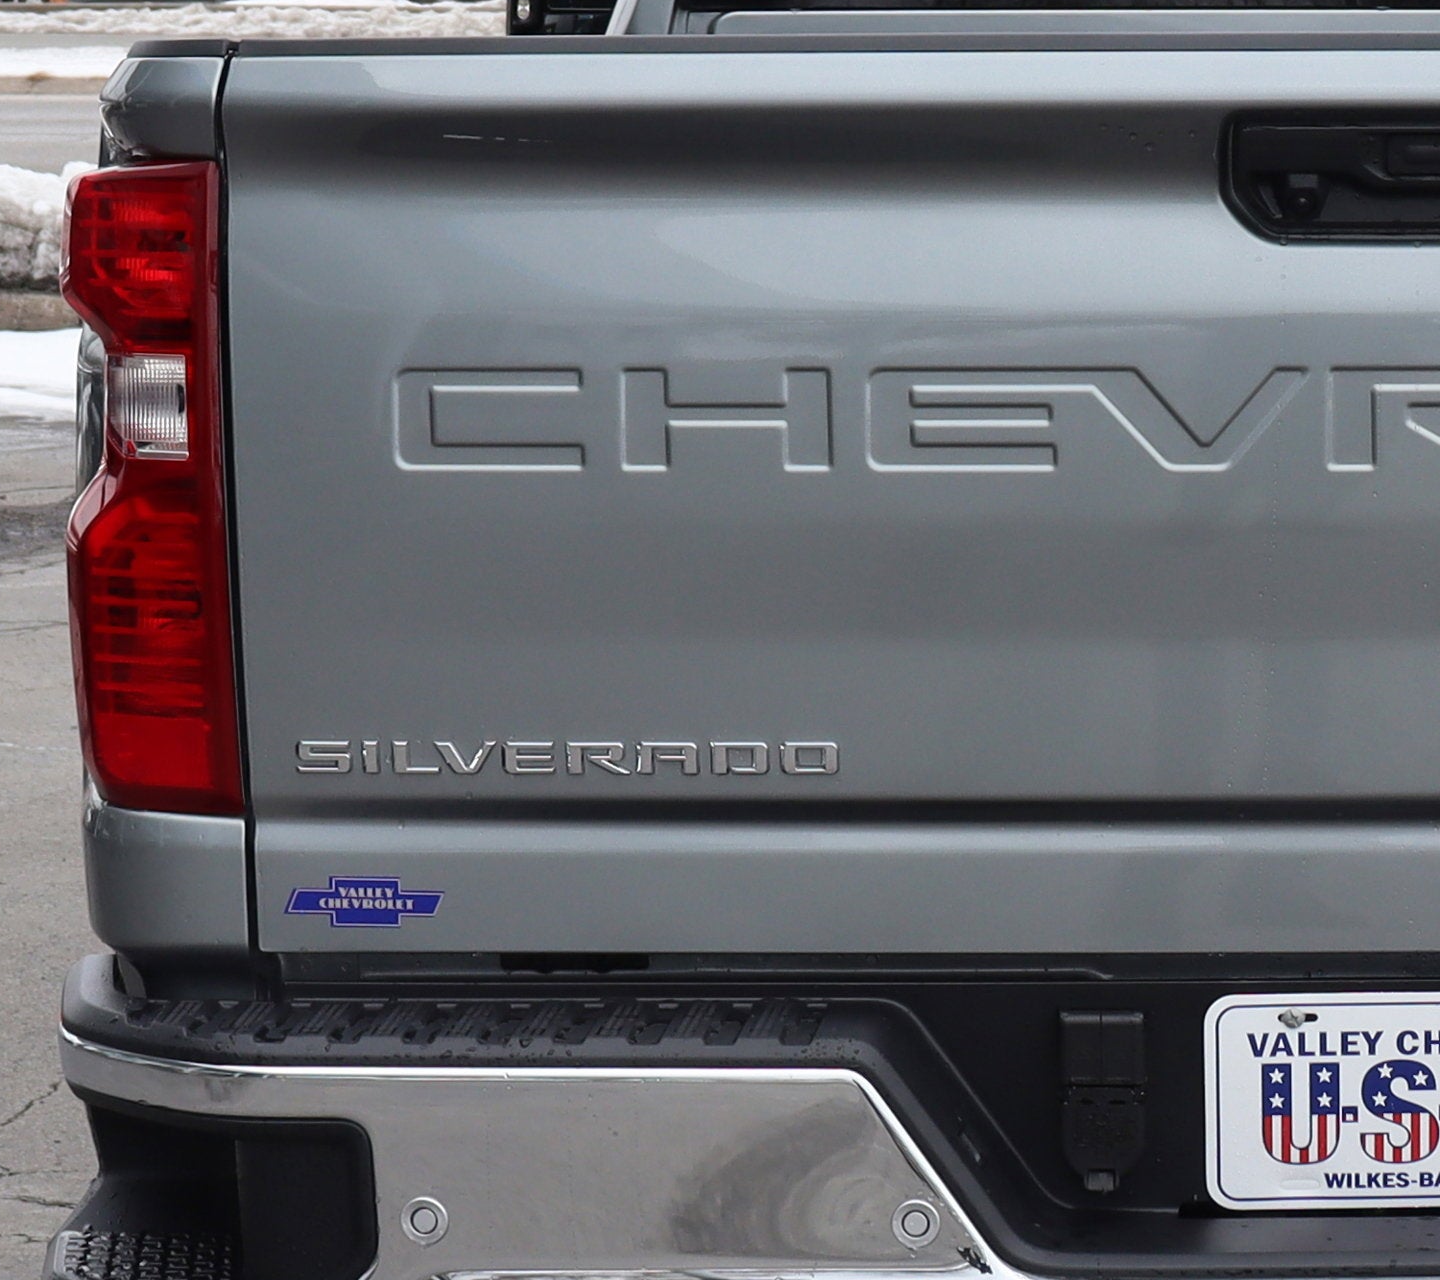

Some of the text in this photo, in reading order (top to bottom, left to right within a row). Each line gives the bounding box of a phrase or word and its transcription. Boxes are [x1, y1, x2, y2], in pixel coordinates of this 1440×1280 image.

[295, 739, 840, 776] SILVERADO
[337, 886, 395, 898] VALLEY
[318, 897, 414, 910] CHEVROLET
[1246, 1030, 1384, 1058] VALLEY
